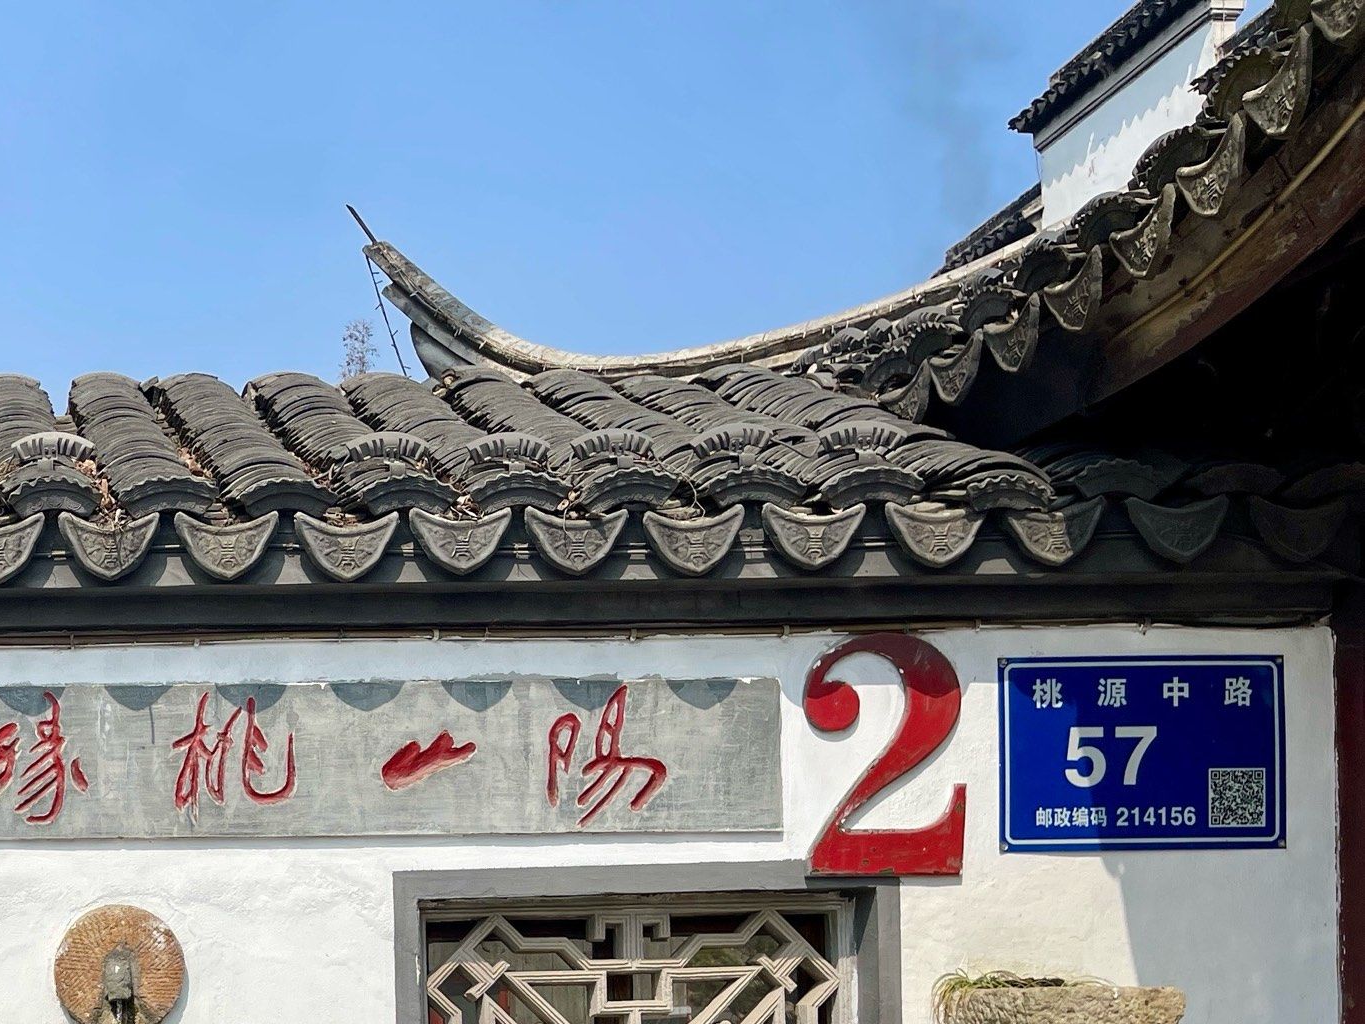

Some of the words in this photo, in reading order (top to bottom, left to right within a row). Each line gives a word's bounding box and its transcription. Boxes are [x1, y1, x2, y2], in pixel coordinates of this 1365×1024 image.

[1032, 677, 1253, 709] 桃源中路
[803, 633, 966, 876] 2
[1064, 726, 1158, 788] 57
[1035, 806, 1107, 828] 邮政编码
[1116, 806, 1197, 827] 214156
